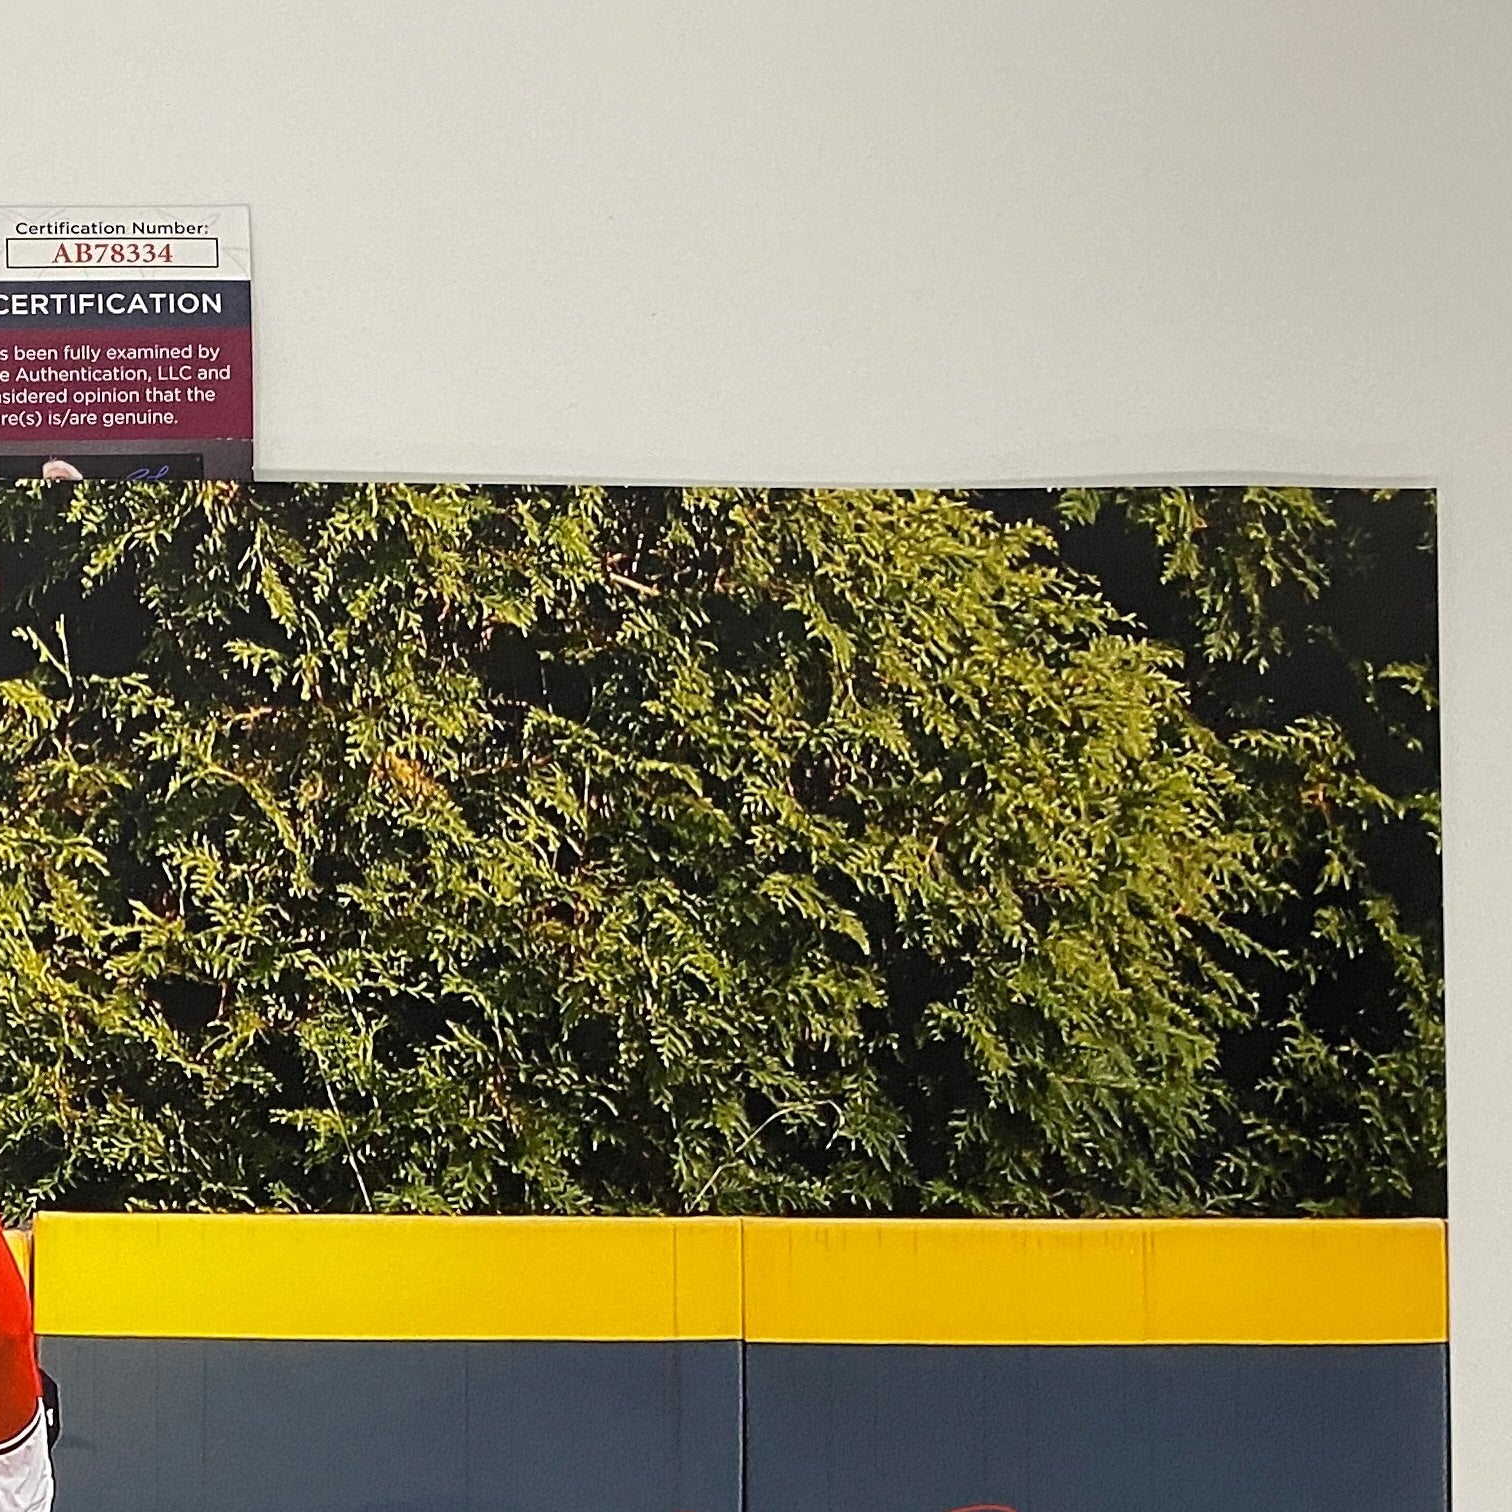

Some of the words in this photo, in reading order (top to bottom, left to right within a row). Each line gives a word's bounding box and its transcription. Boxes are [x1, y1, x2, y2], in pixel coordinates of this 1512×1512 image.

[15, 221, 125, 236] Certification
[132, 221, 209, 236] Number:
[51, 242, 174, 264] AB78334
[14, 345, 58, 361] been
[64, 345, 101, 363] fully
[106, 344, 193, 360] examined
[198, 344, 220, 362] by
[15, 366, 152, 383] Authentication,
[157, 365, 192, 381] LLC
[197, 364, 231, 381] and
[73, 387, 140, 406] opinion
[145, 387, 182, 403] that
[187, 386, 216, 402] the
[48, 409, 98, 428] is/are
[102, 409, 179, 427] genuine.
